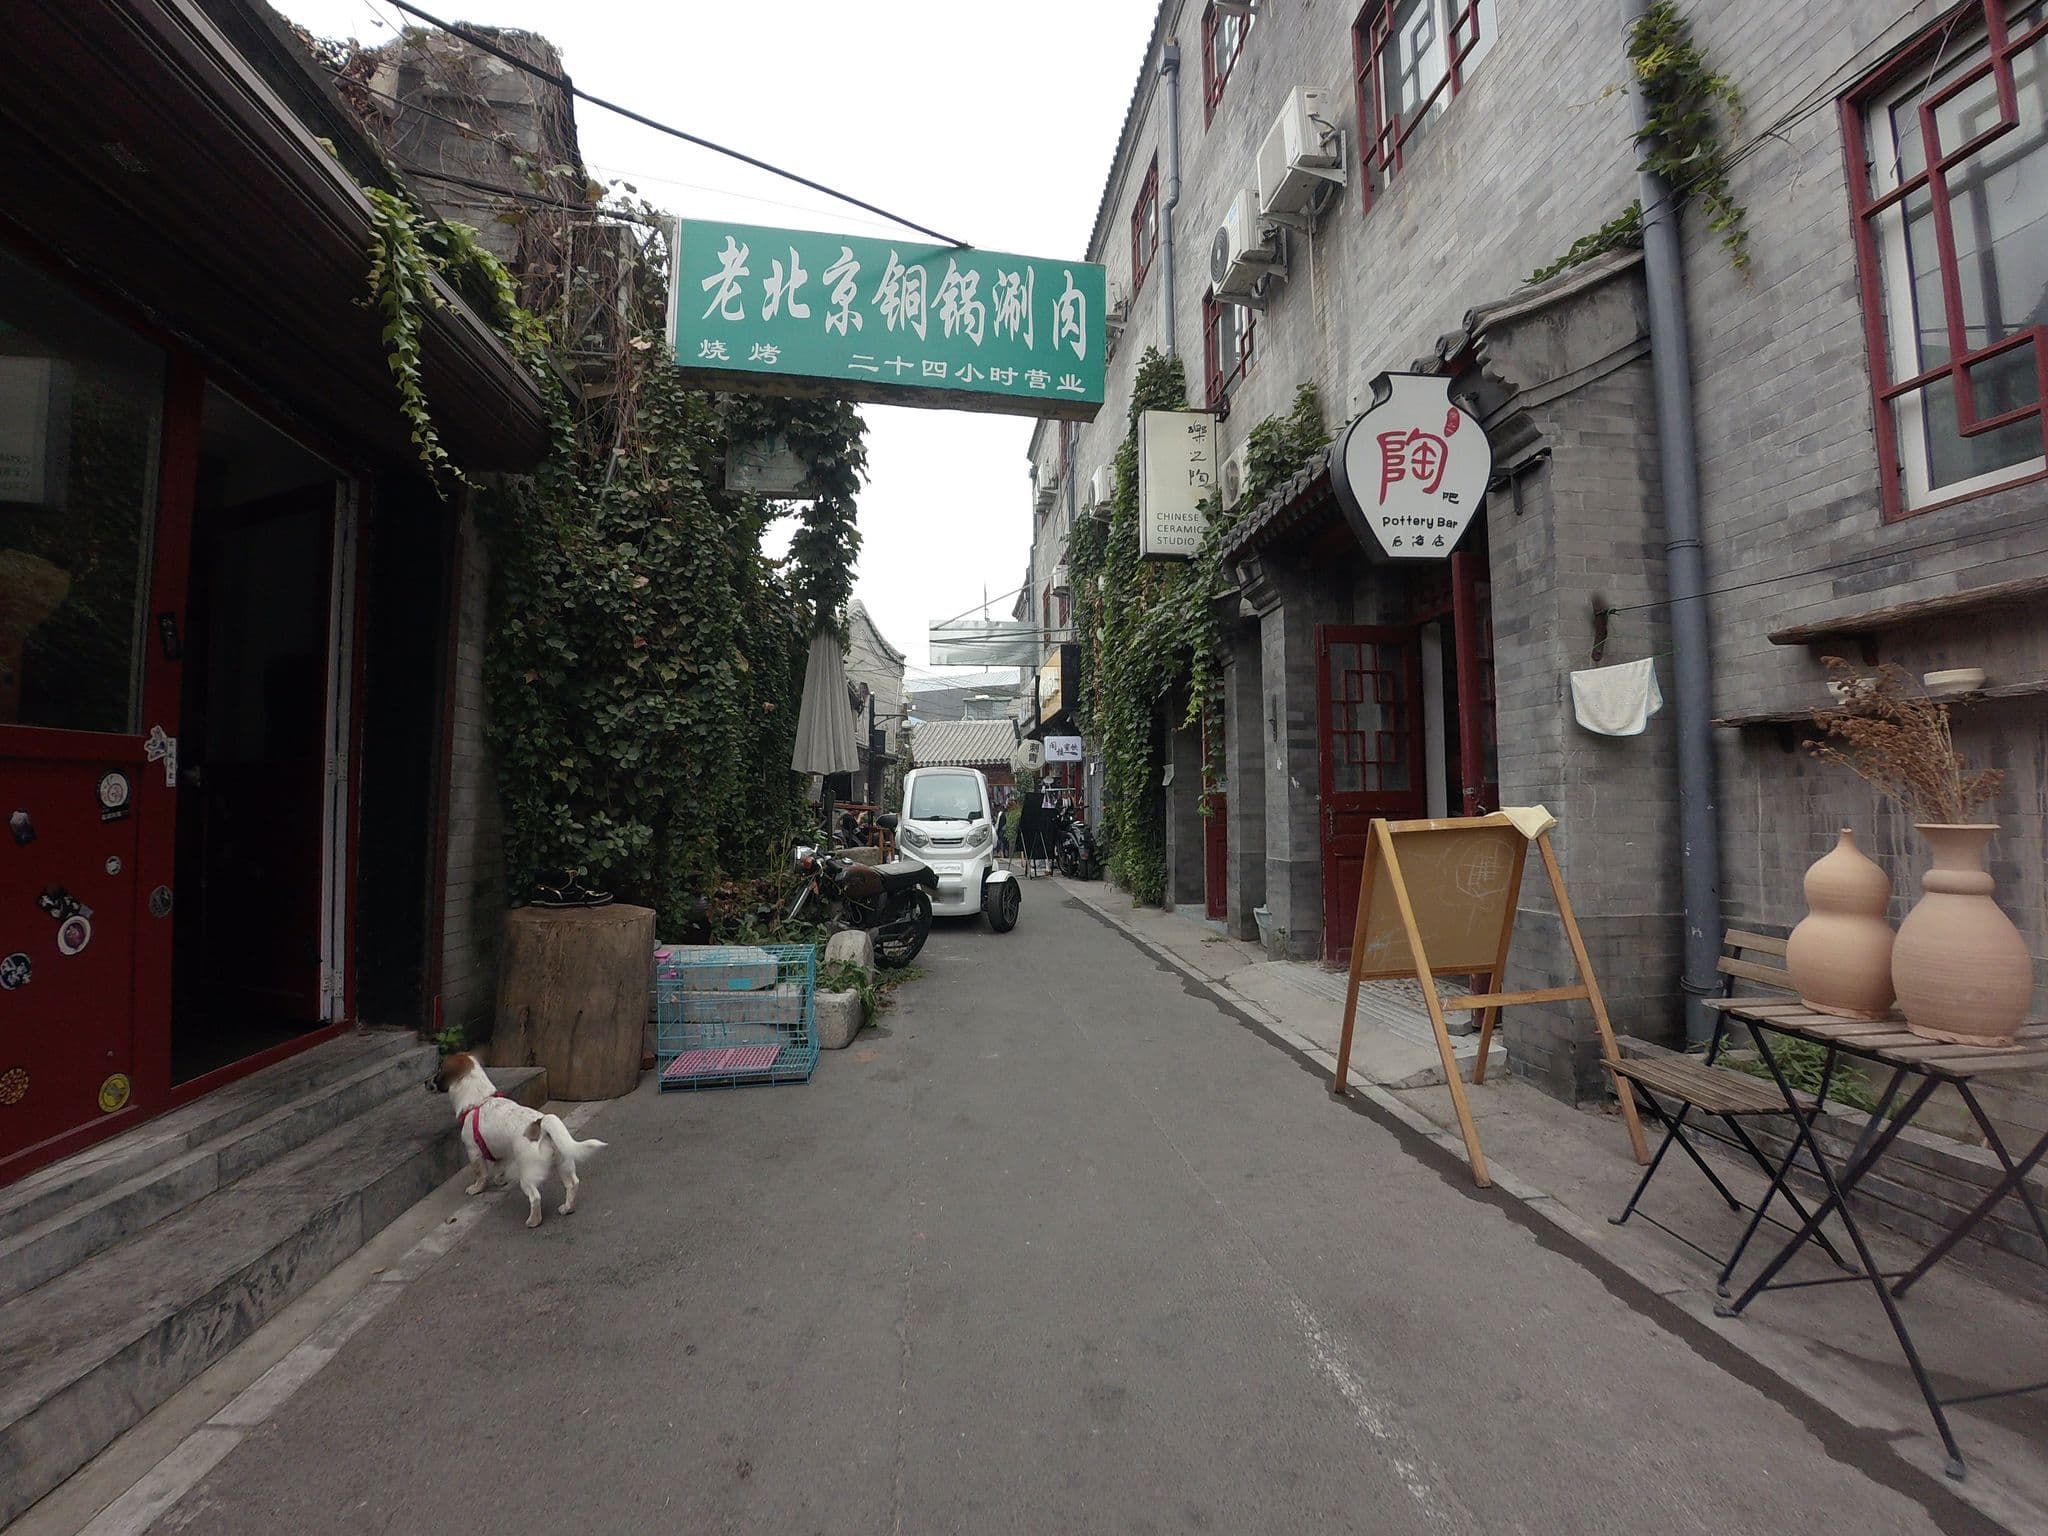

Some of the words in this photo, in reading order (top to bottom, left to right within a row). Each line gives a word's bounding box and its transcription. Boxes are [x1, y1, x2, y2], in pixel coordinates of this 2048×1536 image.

[701, 235, 1088, 361] 老北京铜锅涮肉
[697, 338, 782, 365] 烧烤
[847, 353, 1087, 394] 二十四小时营业
[1156, 512, 1199, 521] CHINESE
[1382, 515, 1434, 529] Pottery
[1437, 517, 1458, 529] Bar
[1156, 536, 1195, 546] STUDIO
